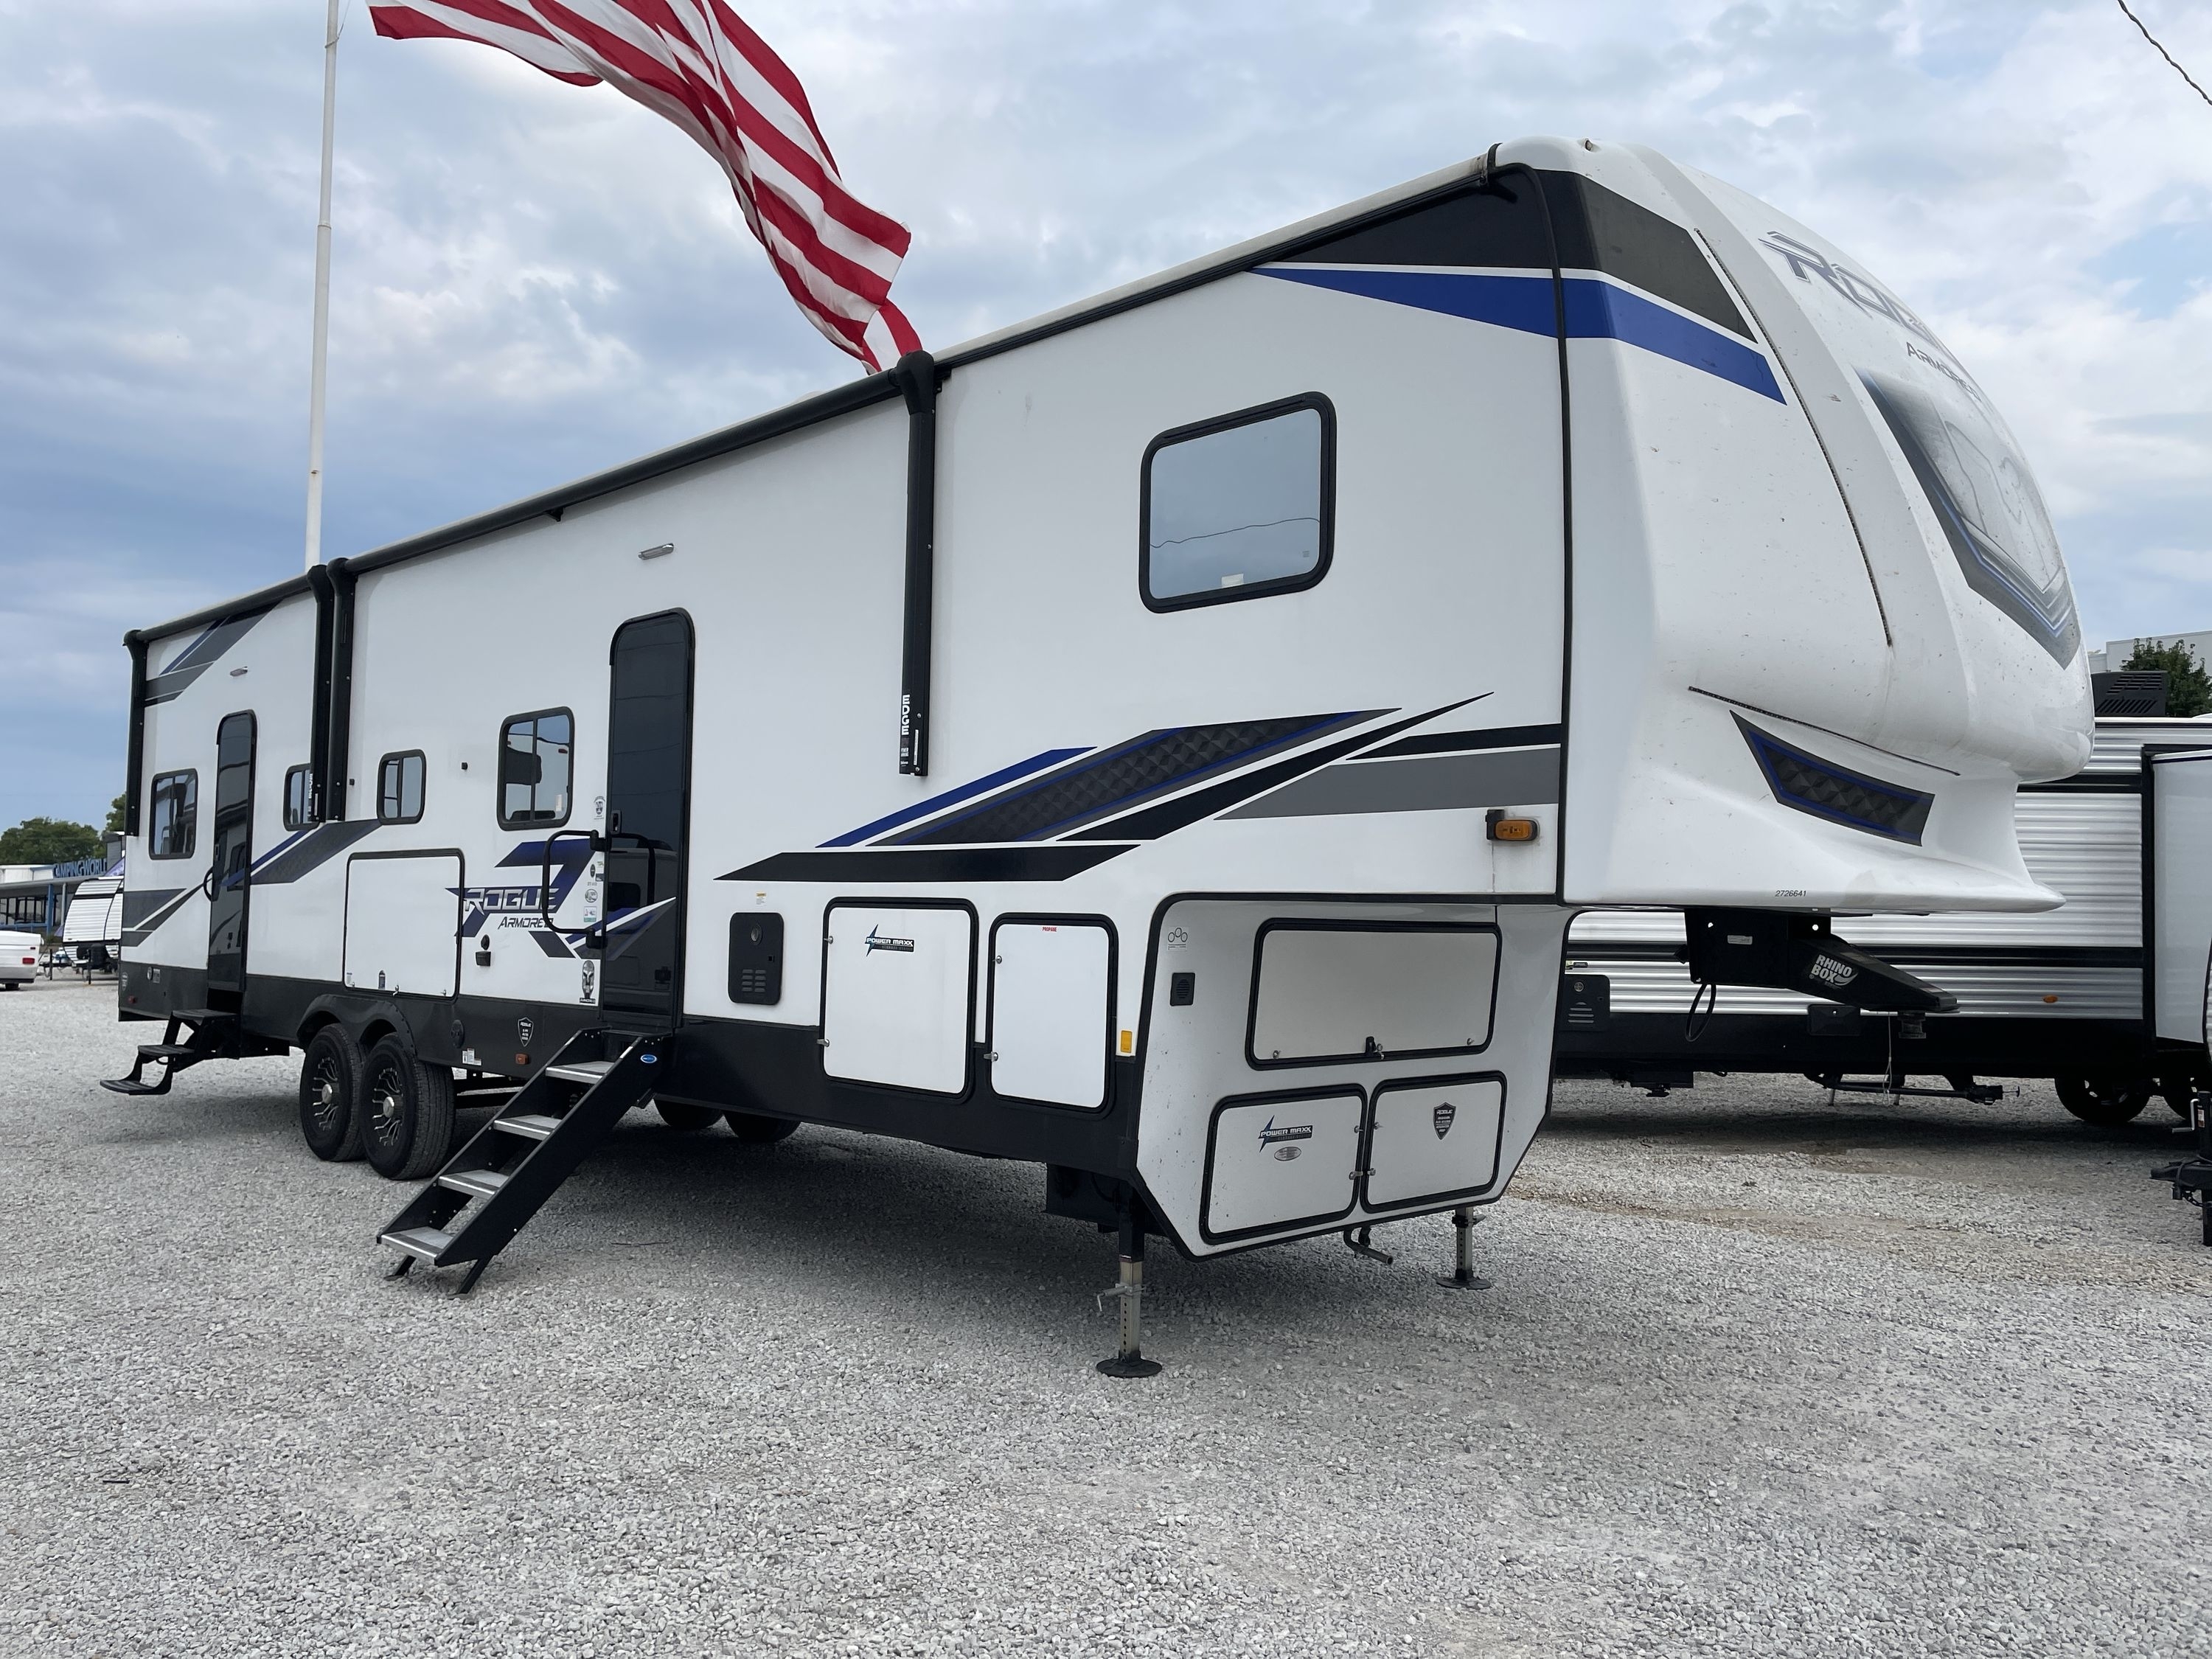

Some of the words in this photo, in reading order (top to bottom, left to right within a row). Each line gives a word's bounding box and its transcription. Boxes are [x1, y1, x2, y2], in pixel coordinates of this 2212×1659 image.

[901, 694, 911, 736] EDGE
[53, 860, 84, 878] CAMPING
[1775, 889, 1806, 897] 2726641
[1811, 964, 1837, 983] BOX
[1815, 954, 1852, 977] RHINO
[1260, 1129, 1289, 1137] POWER
[1290, 1126, 1312, 1134] MAXX
